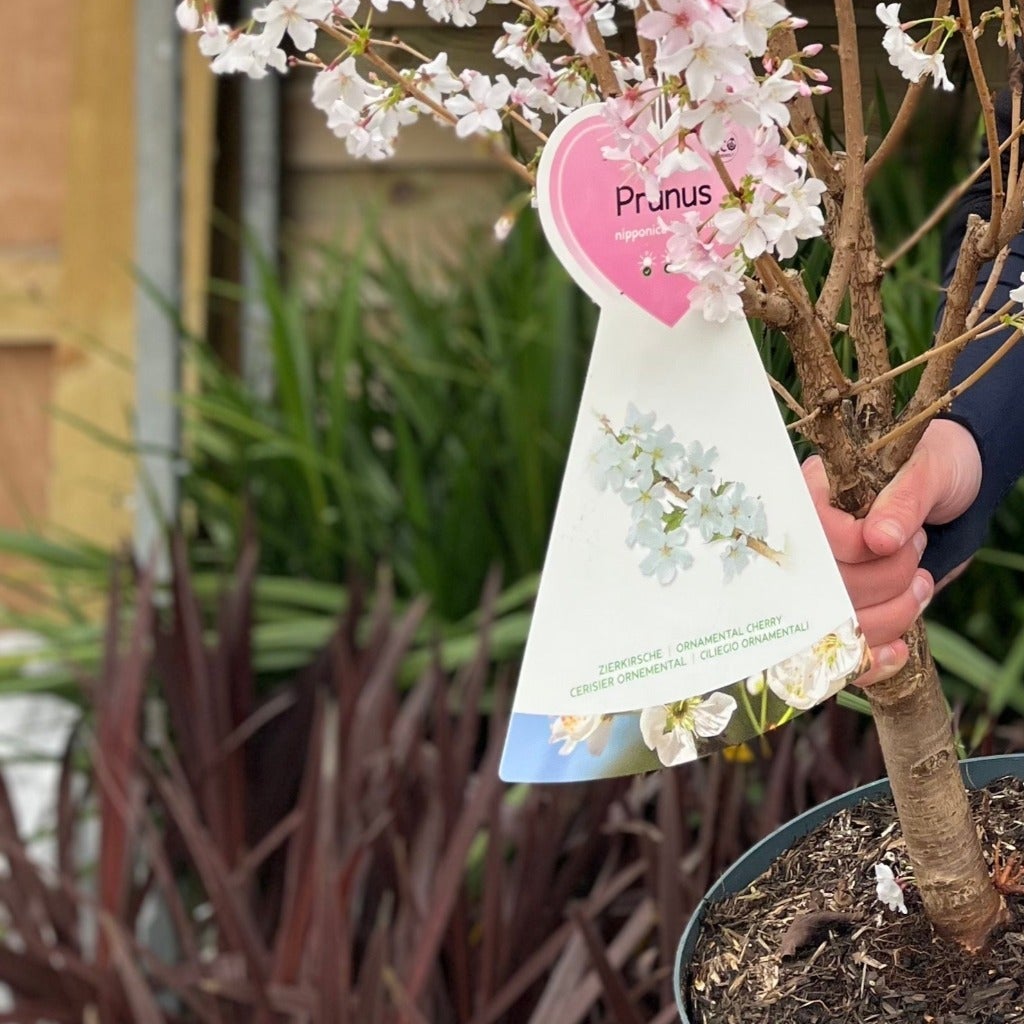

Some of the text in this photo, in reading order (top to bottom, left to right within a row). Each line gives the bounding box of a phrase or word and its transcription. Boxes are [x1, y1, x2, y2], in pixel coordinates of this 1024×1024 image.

[616, 184, 712, 216] Prunus
[569, 677, 615, 697] CERISIER
[617, 657, 687, 684] ORNEMENTAL
[700, 642, 739, 660] CILIEGIO
[598, 615, 783, 675] ZIERKIRSCHE ORNAMENTAL CHERRY
